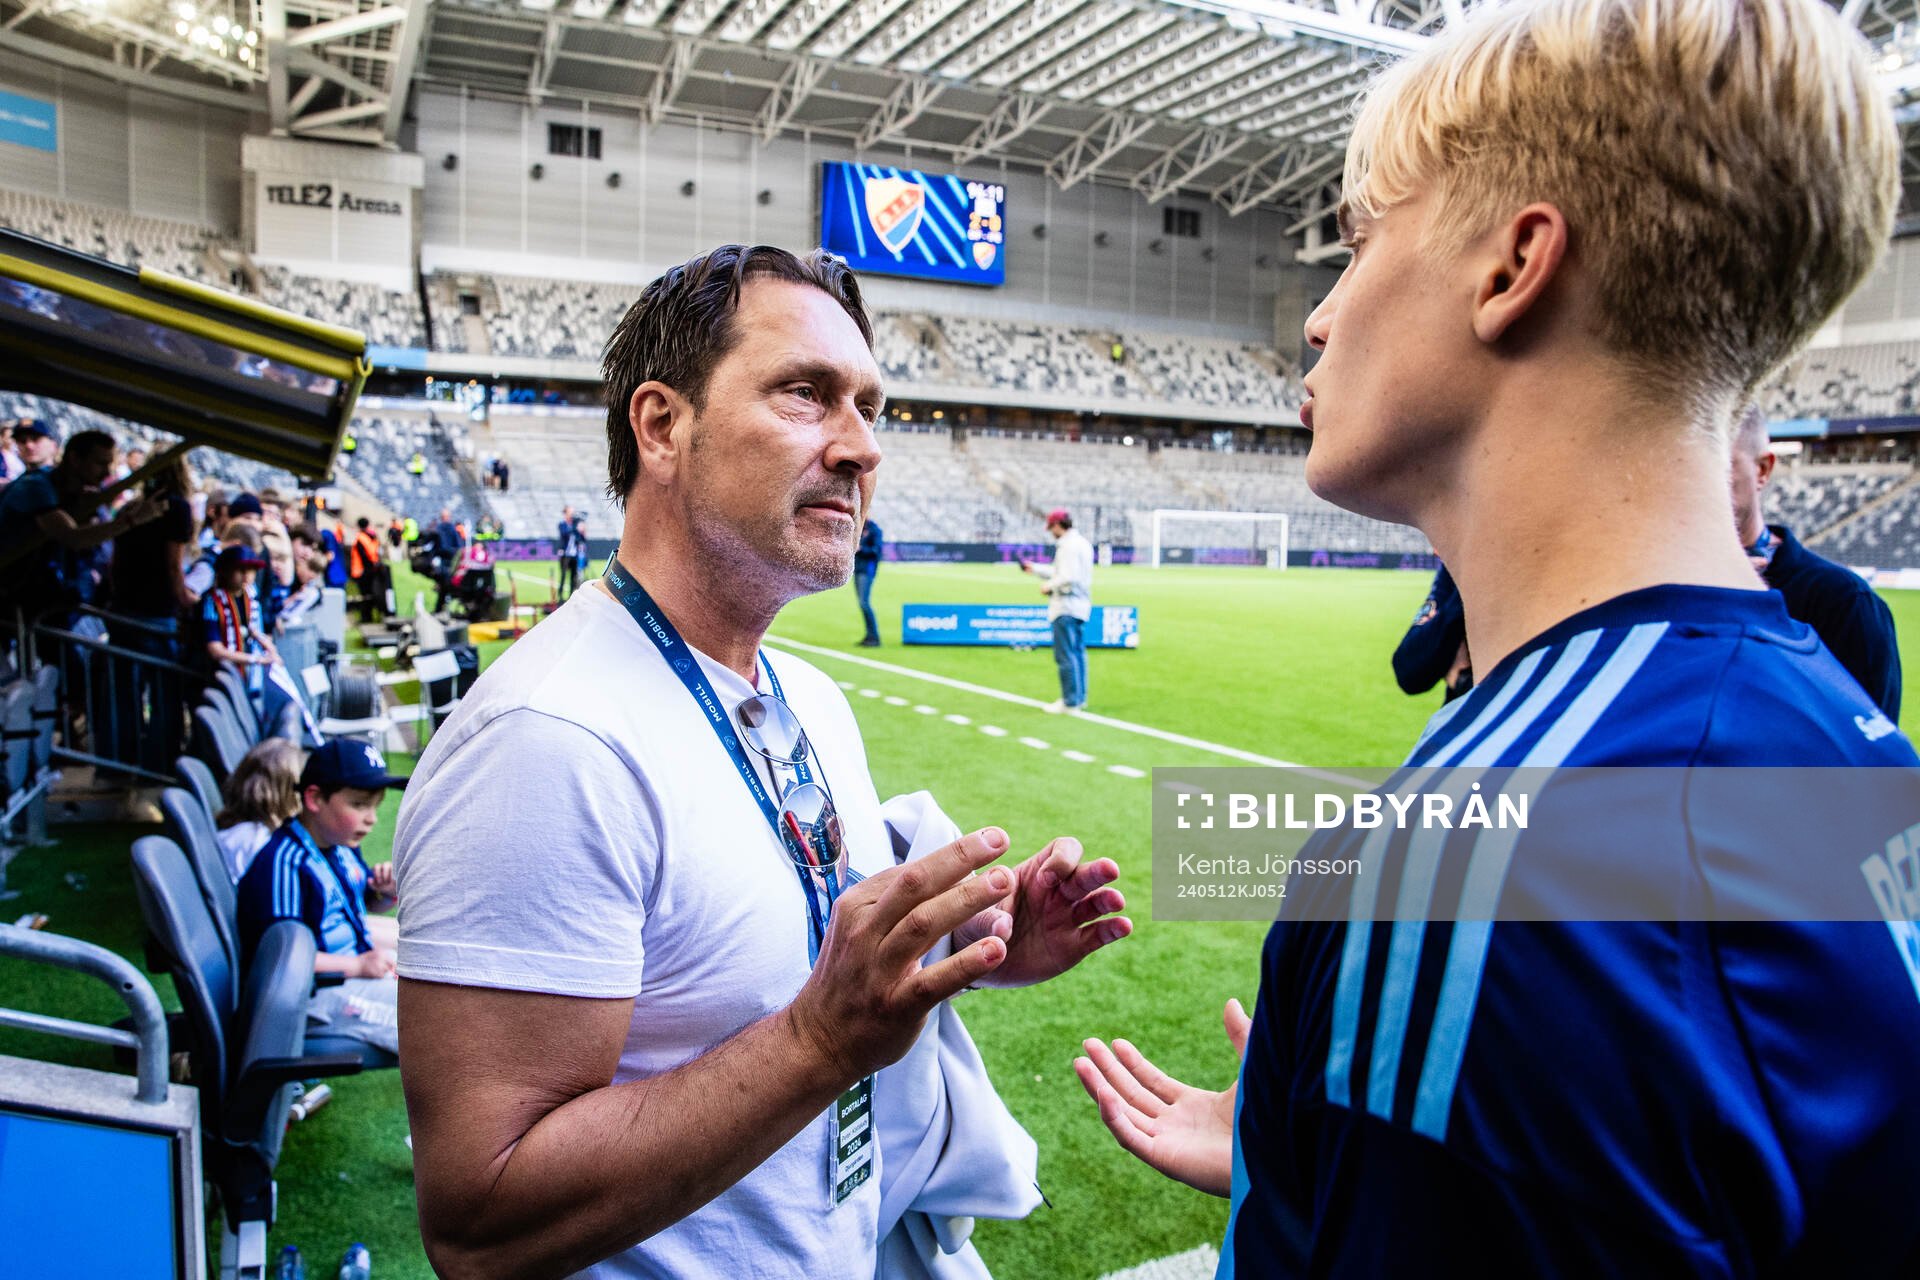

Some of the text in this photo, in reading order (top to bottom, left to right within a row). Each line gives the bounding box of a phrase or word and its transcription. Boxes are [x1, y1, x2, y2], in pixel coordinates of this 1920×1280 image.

[266, 184, 402, 216] TELE2 Arena
[643, 611, 674, 647] MOBILL
[695, 683, 723, 723] MOBILL
[742, 760, 765, 801] MOBILL
